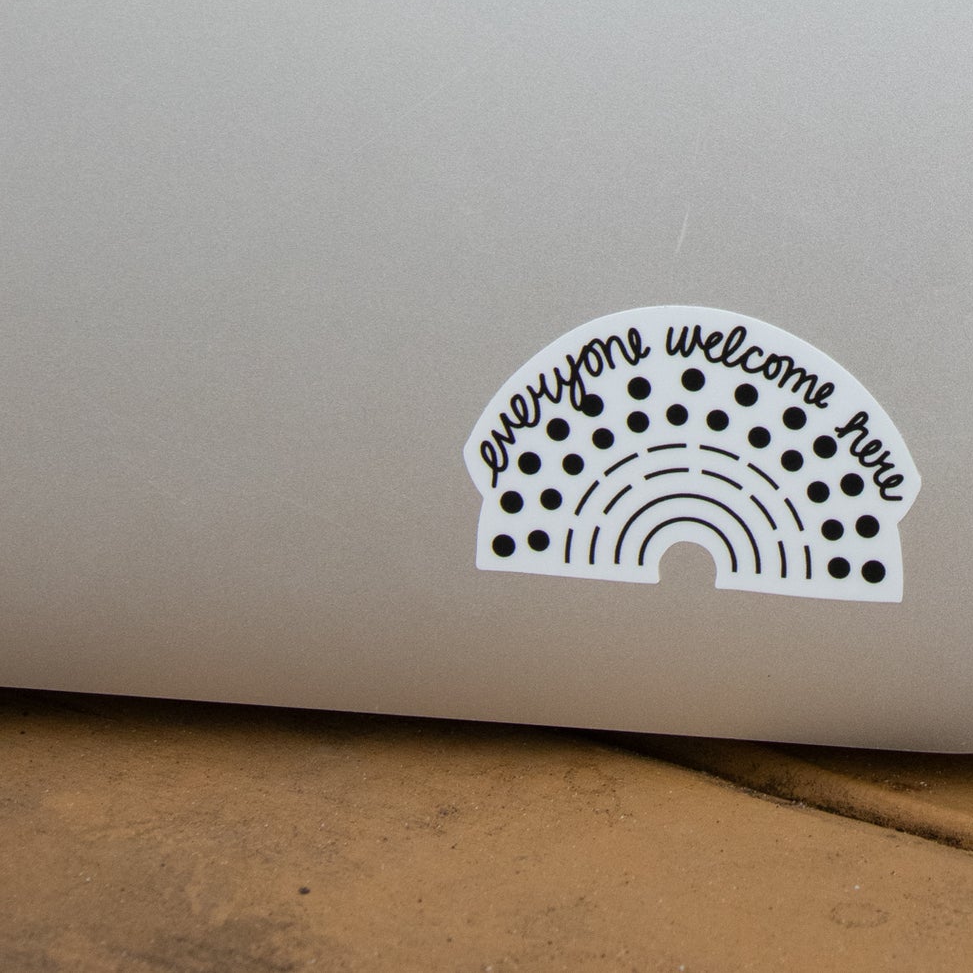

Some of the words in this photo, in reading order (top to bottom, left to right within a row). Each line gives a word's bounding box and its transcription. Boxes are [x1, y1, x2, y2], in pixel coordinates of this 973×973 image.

[480, 328, 651, 488] everyone
[666, 325, 835, 408] welcome
[835, 411, 904, 502] here
